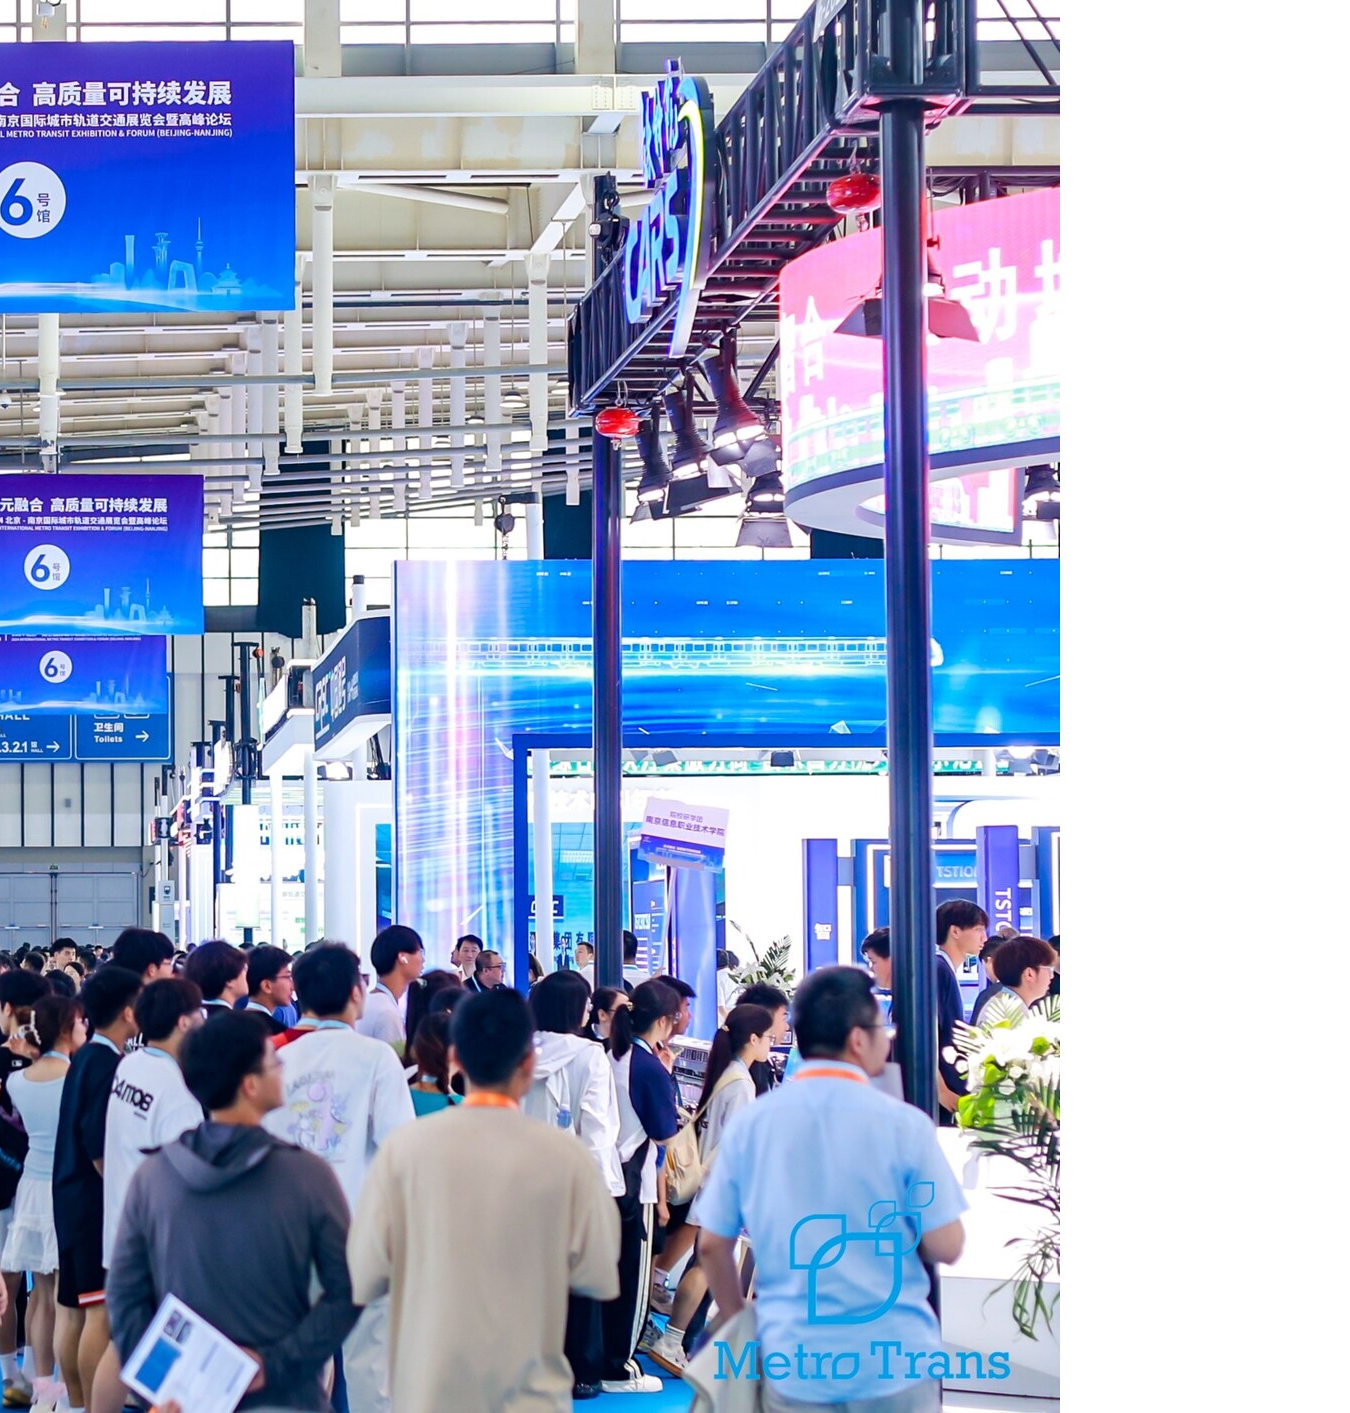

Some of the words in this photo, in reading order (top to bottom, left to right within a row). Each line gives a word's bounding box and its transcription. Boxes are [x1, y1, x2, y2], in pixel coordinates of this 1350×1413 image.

[32, 80, 232, 107] 高质量可持续发展
[6, 130, 35, 138] METRO
[36, 130, 70, 138] TRANSIT
[71, 129, 117, 138] EXHIBITION
[118, 129, 125, 137] &
[126, 129, 156, 137] FORUM
[157, 129, 233, 138] (BEIJING-NANJING)
[0, 178, 34, 227] 6
[624, 168, 681, 324] CARS
[50, 497, 168, 513] 高质量可持续发展
[5, 515, 22, 525] 北京
[31, 554, 50, 582] 6
[44, 657, 58, 678] 6
[94, 722, 124, 733] 卫生间
[93, 735, 123, 743] Toilets
